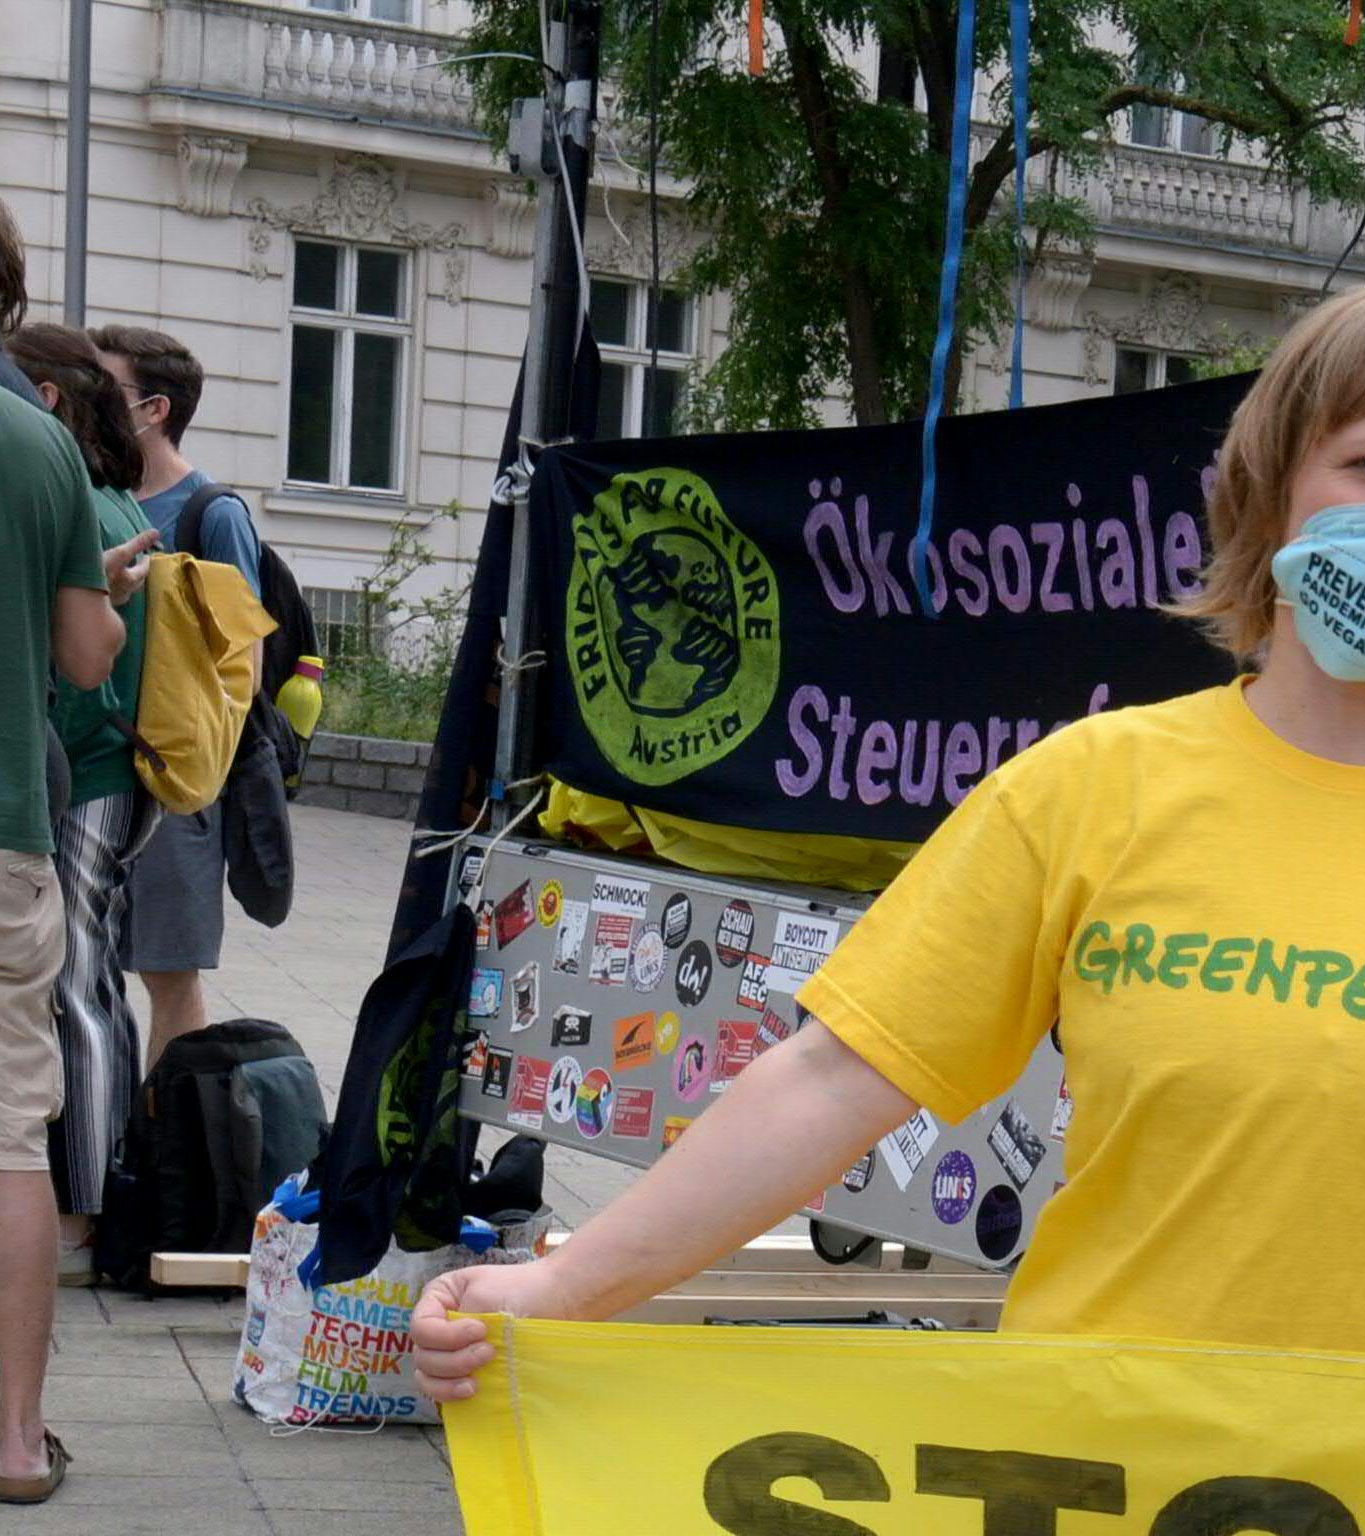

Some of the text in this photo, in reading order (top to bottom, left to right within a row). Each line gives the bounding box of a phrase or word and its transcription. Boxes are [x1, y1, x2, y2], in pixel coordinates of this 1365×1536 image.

[803, 475, 1203, 618] Ökosoziale
[1300, 592, 1320, 616] GO
[628, 711, 743, 766] Austria
[592, 882, 648, 909] SCHMOCK!
[720, 907, 754, 935] SCHAU
[784, 923, 829, 949] BOYCOTT
[302, 1335, 402, 1376] MUSIK
[299, 1358, 369, 1395] FILM
[295, 1382, 417, 1417] TRENDS
